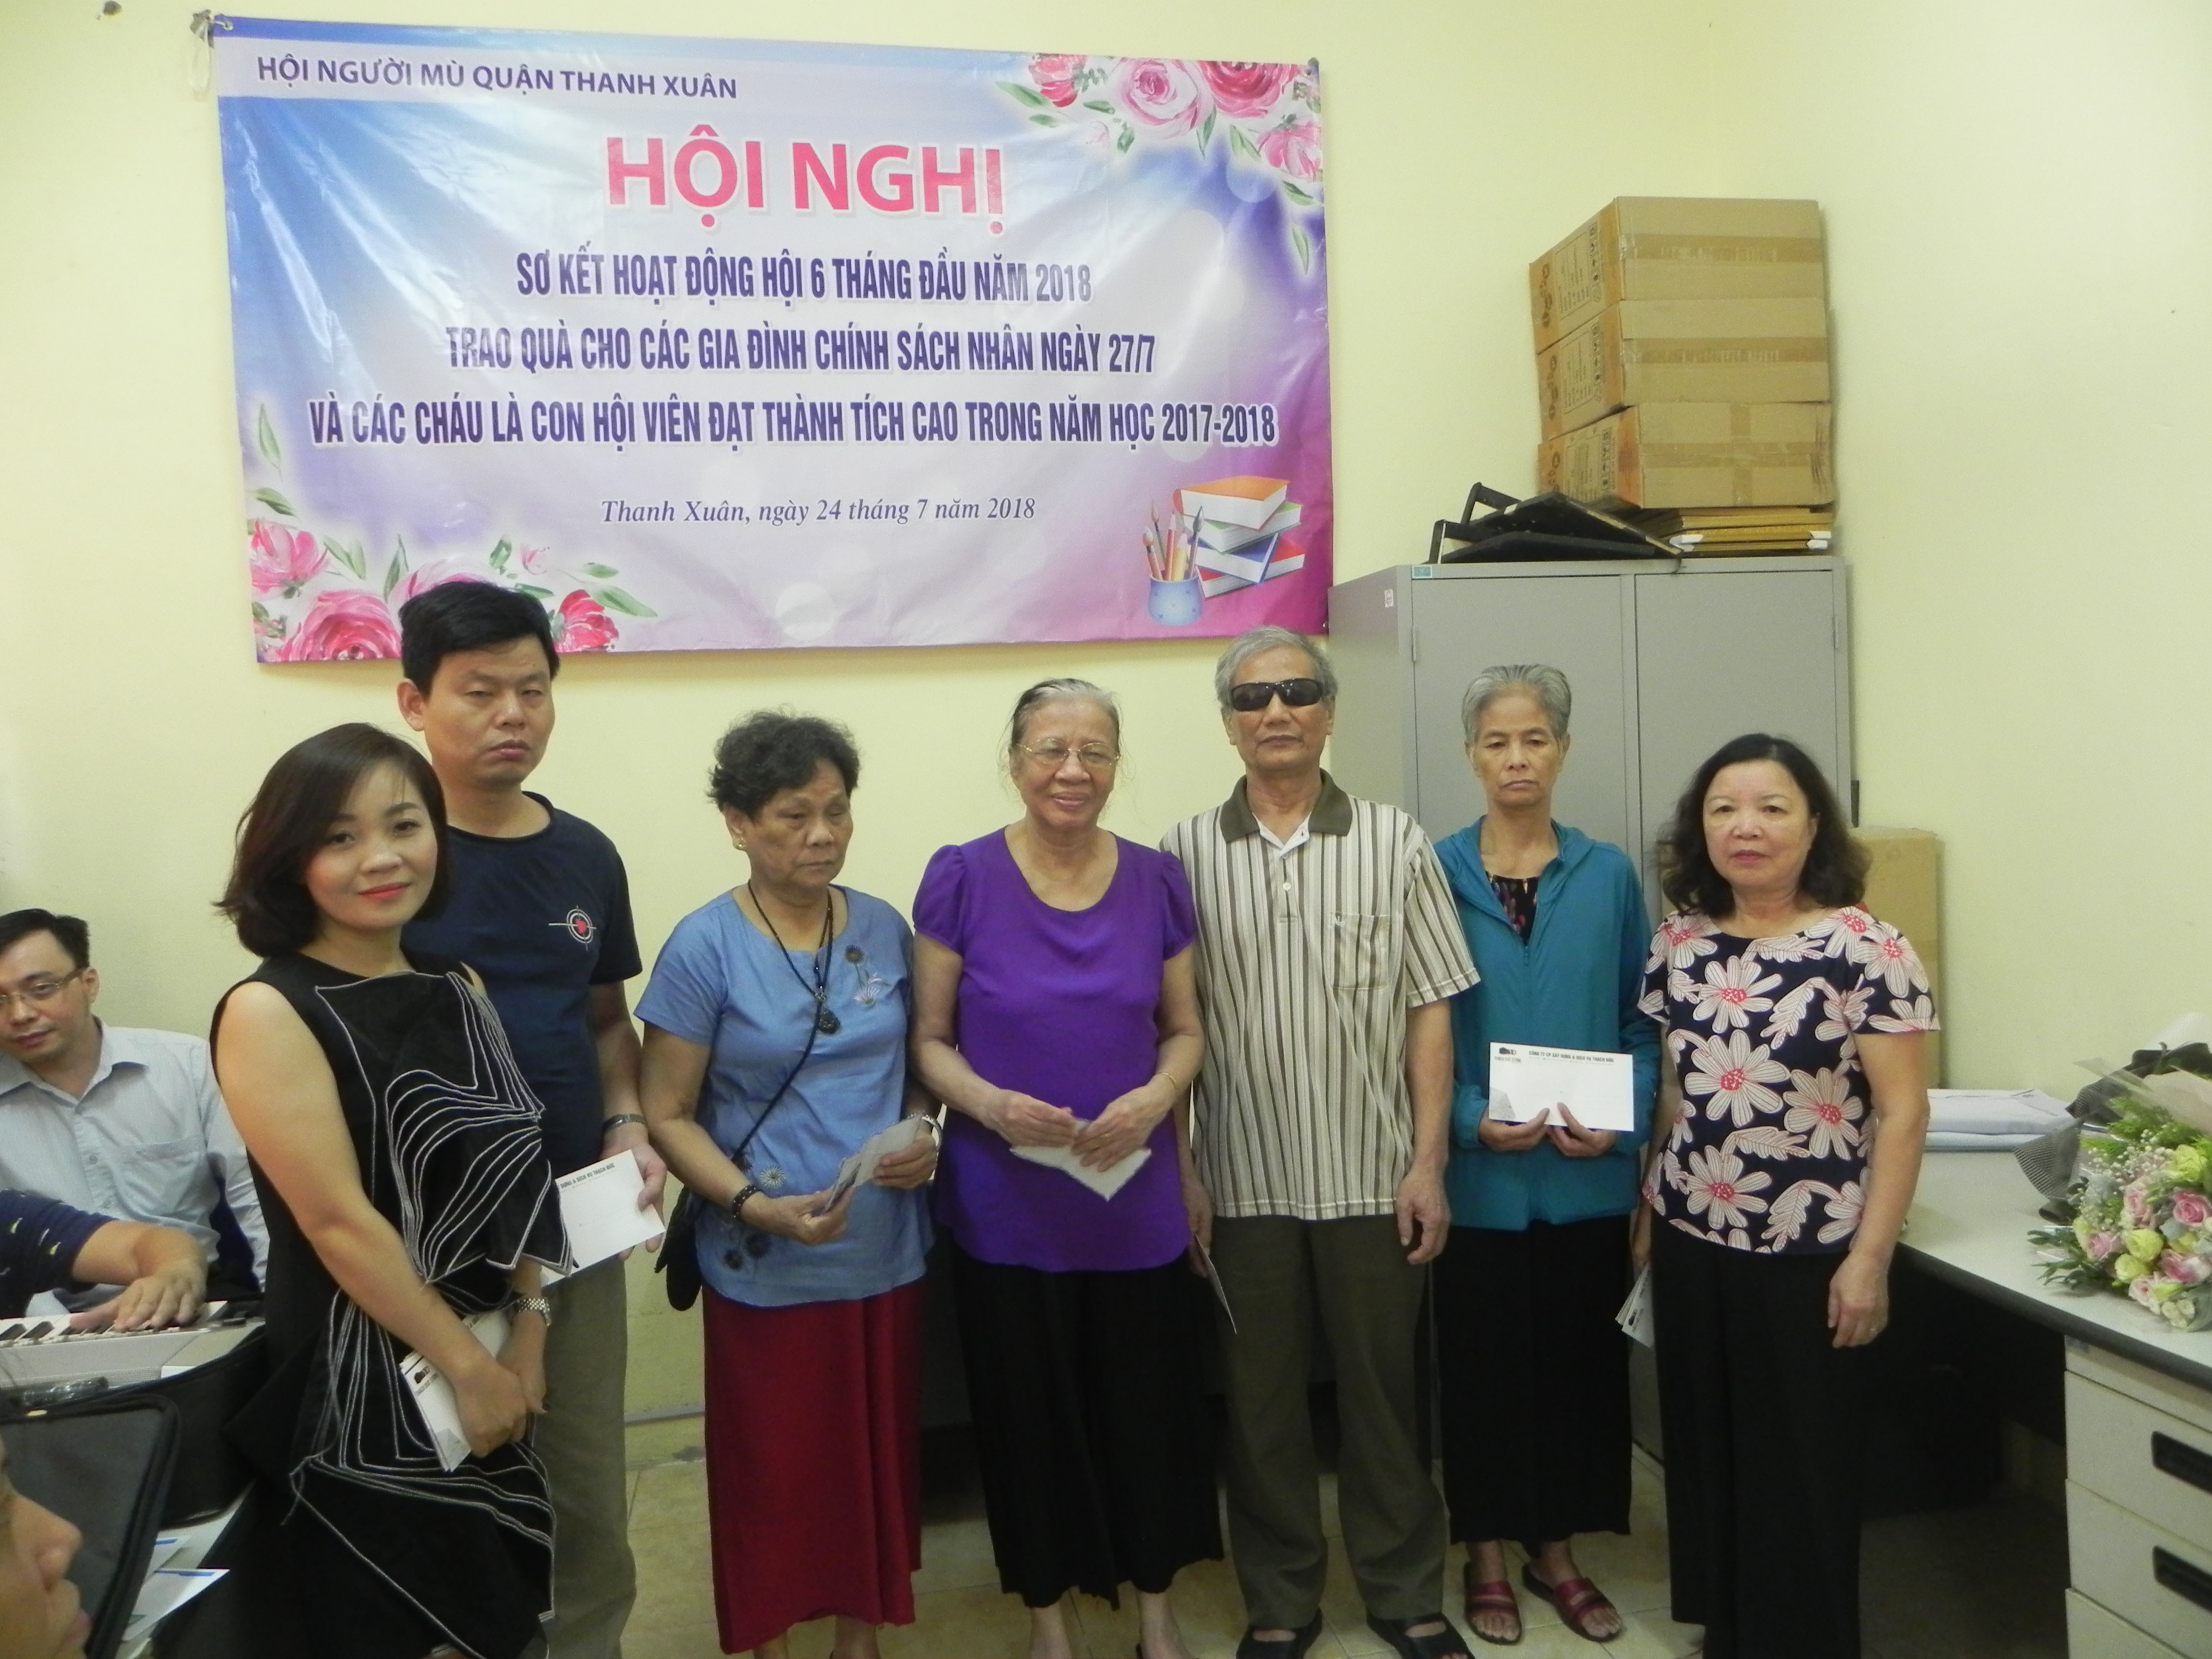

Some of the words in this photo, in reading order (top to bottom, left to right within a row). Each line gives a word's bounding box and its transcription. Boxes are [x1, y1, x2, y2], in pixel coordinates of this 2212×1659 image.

[258, 53, 309, 90] HỘI
[318, 57, 411, 85] NGƯỜI
[421, 59, 464, 87] MÙ
[472, 64, 554, 95] QUẬN
[560, 70, 655, 95] THANH
[663, 73, 737, 99] XUÂN
[608, 124, 764, 228] HỘI
[792, 142, 1002, 234] NGHỊ
[517, 250, 551, 295] SƠ
[558, 241, 604, 295] KẾT
[613, 254, 677, 305] HOẠT
[685, 247, 754, 306] ĐỘNG
[762, 248, 803, 307] HỘI
[810, 258, 825, 298] 6
[831, 250, 912, 300] THÁNG
[919, 246, 967, 301] ĐẦU
[974, 253, 1028, 301] NĂM
[1035, 263, 1091, 303] 2018
[446, 327, 512, 369] TRAO
[521, 319, 574, 374] QUÀ
[581, 327, 631, 369] CHO
[639, 319, 690, 369] CÁC
[698, 328, 740, 369] GIA
[746, 320, 807, 369] ĐÌNH
[814, 321, 890, 370] CHÍNH
[897, 323, 960, 371] SÁCH
[968, 323, 1034, 370] NHÂN
[1041, 324, 1101, 372] NGÀY
[1108, 333, 1155, 374] 27/7
[309, 392, 344, 443] VÀ
[352, 394, 406, 444] CÁC
[415, 392, 483, 444] CHÁU
[491, 392, 523, 442] LÀ
[531, 401, 585, 442] CON
[593, 392, 635, 452] HỘI
[642, 393, 701, 442] VIÊN
[708, 401, 755, 452] ĐẠT
[762, 393, 844, 441] THÀNH
[850, 393, 905, 441] TÍCH
[912, 401, 958, 441] CAO
[965, 401, 1042, 442] TRONG
[1049, 395, 1102, 442] NĂM
[1109, 403, 1155, 450] HỌC
[1161, 403, 1276, 445] 2017-2018
[602, 500, 675, 522] Thanh
[684, 500, 750, 523] Xuân,
[759, 500, 809, 526] ngày
[816, 499, 841, 520] 24
[848, 498, 910, 524] tháng
[917, 498, 928, 519] 7
[935, 499, 979, 519] năm
[987, 497, 1036, 518] 2018
